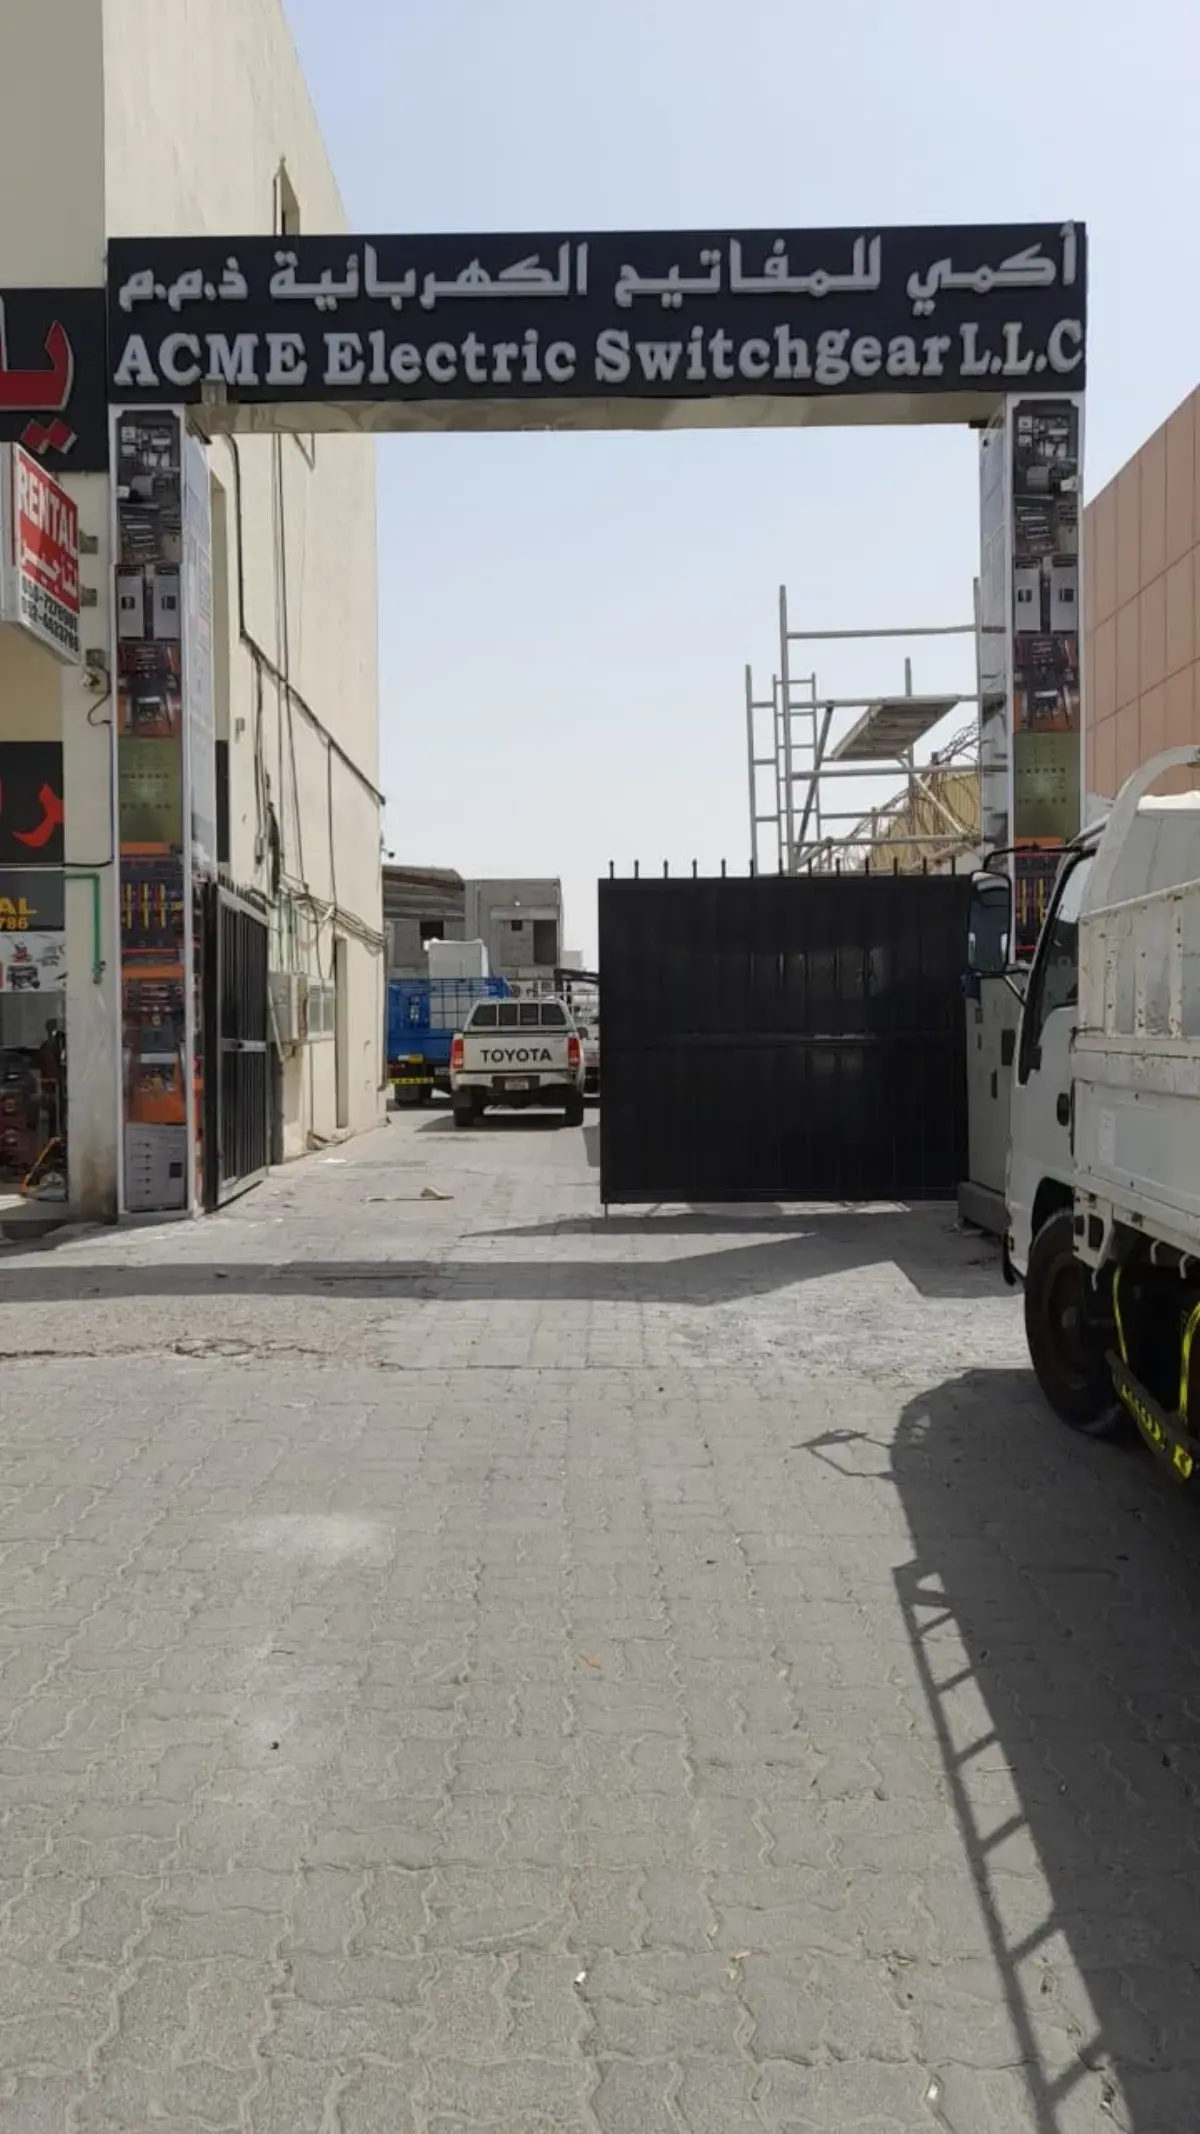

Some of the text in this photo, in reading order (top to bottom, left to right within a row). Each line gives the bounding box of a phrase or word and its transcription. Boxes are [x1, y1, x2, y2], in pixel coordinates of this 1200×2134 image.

[119, 256, 248, 311] ذ.م.م
[614, 234, 882, 308] للمفاتيح
[114, 318, 1083, 386] ACME Electric Switchgear L.L.C
[17, 462, 78, 559] RENTAL
[480, 1048, 553, 1063] TOYOTA
